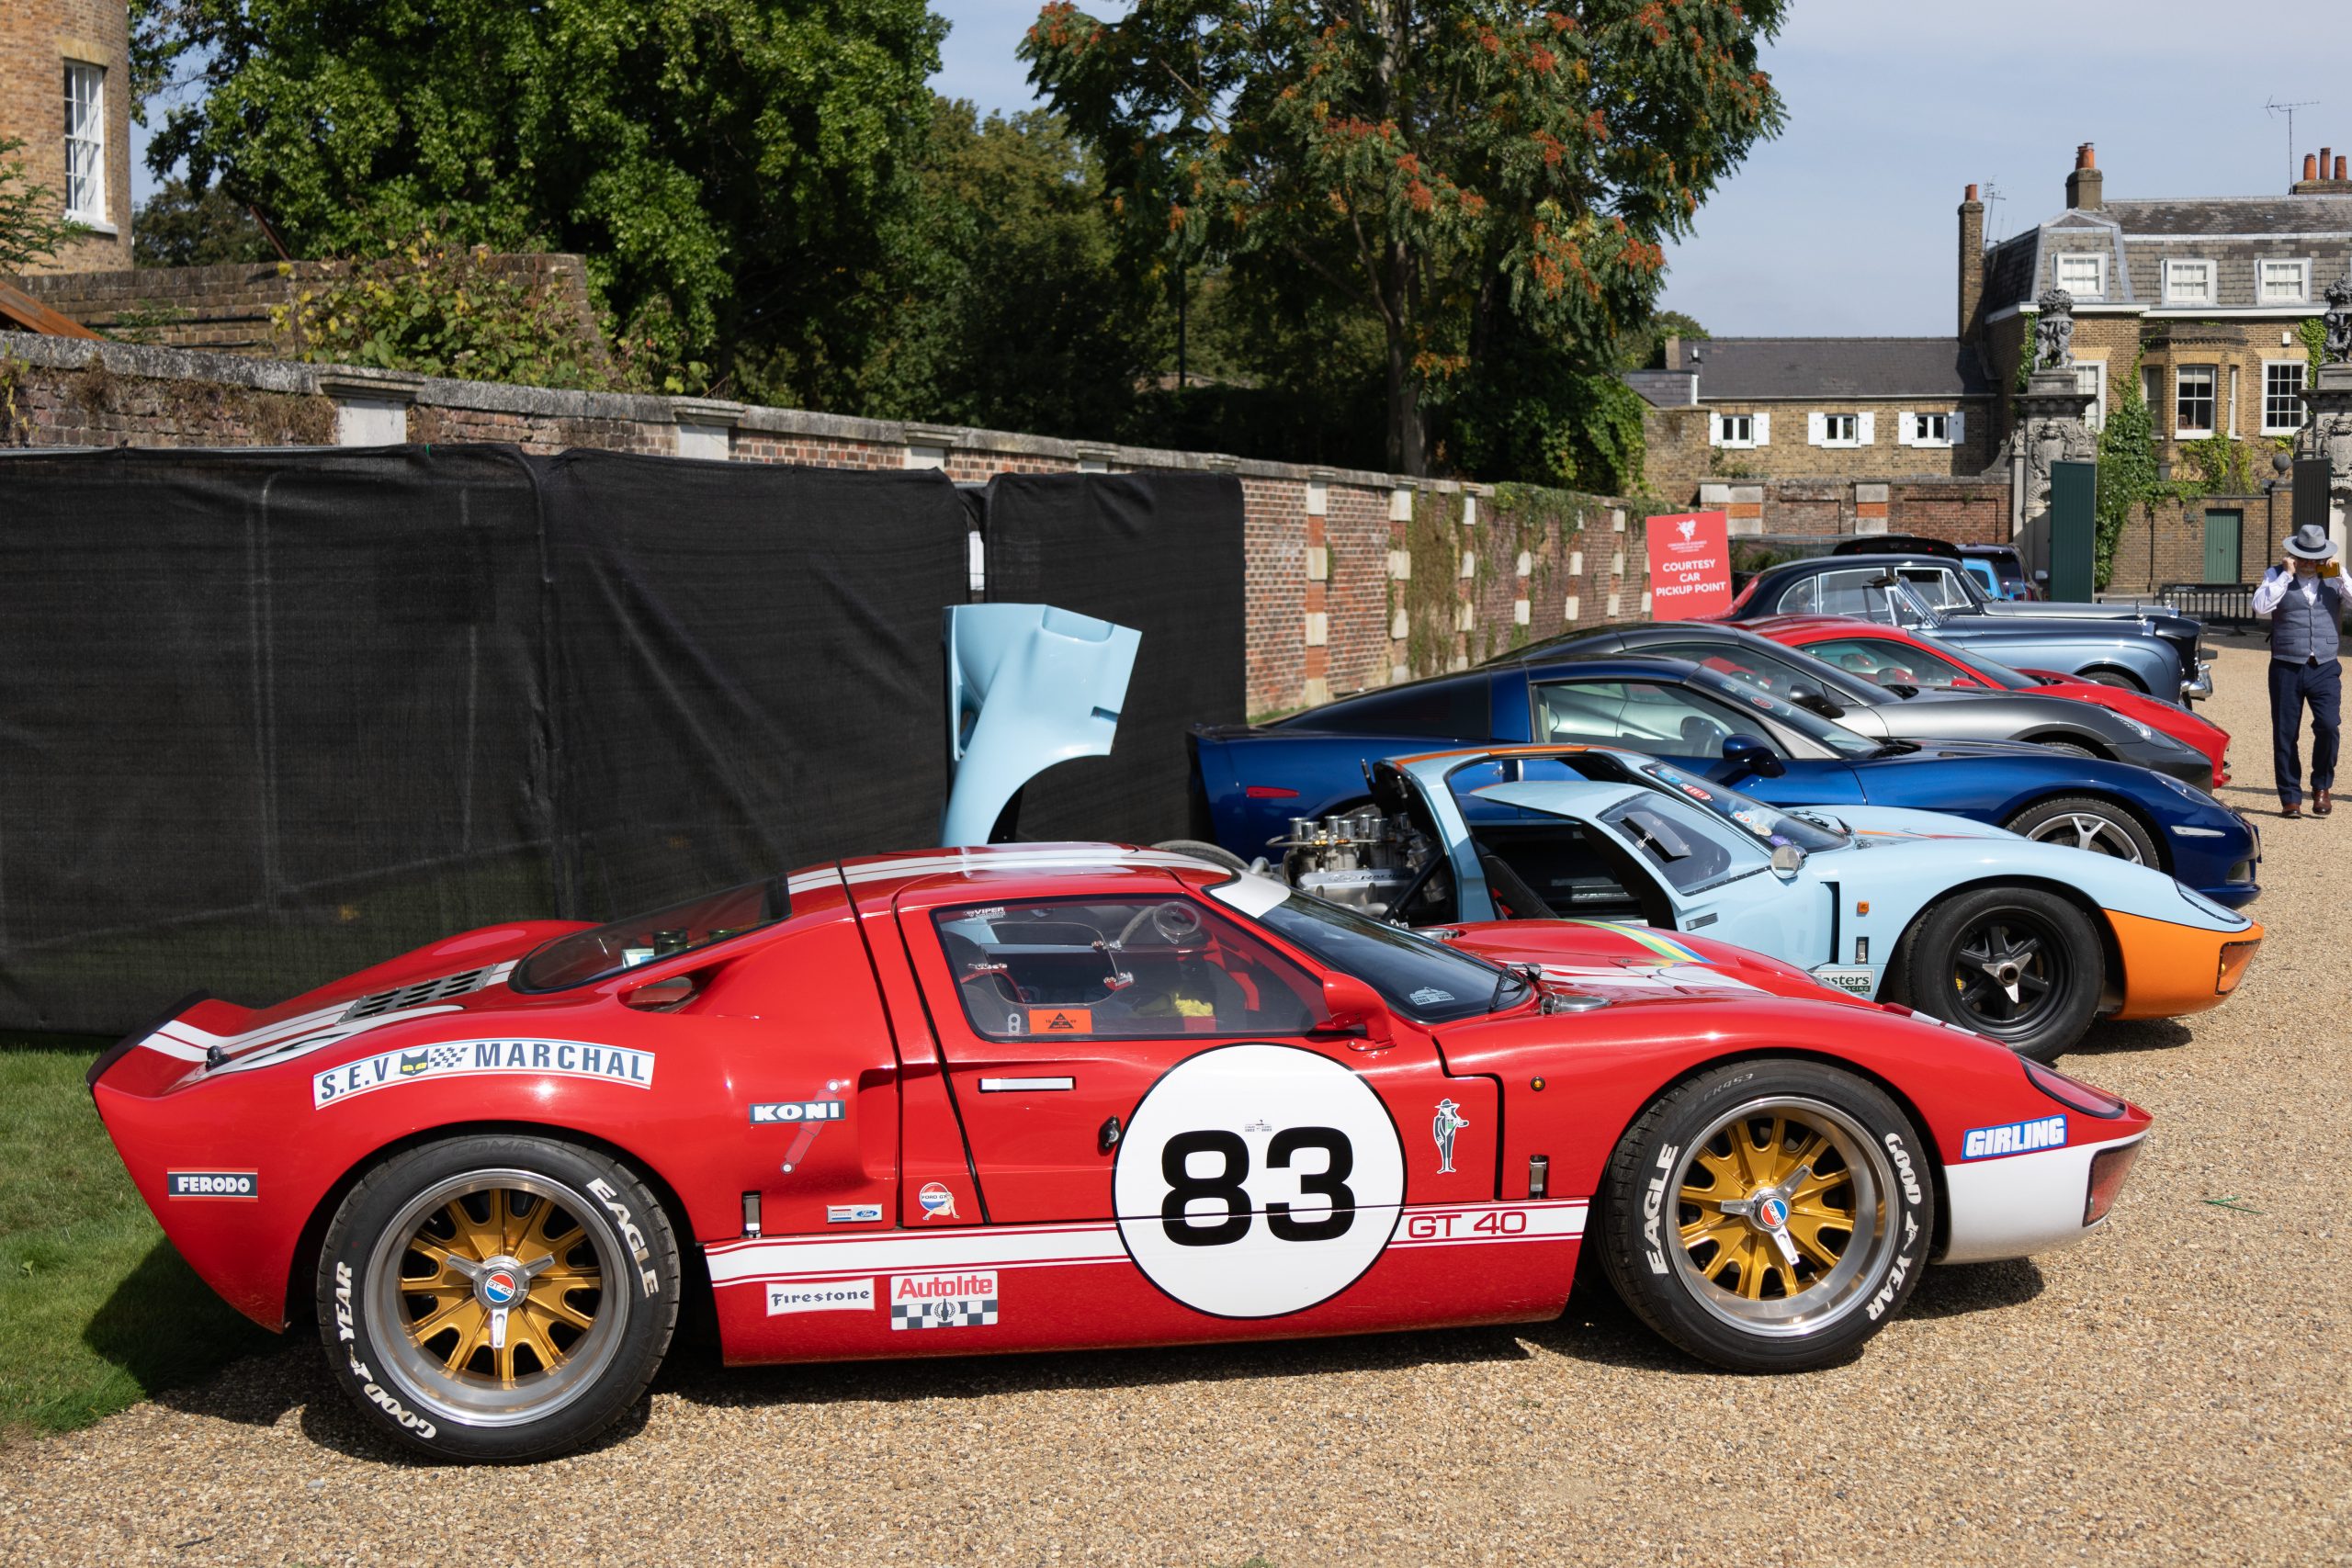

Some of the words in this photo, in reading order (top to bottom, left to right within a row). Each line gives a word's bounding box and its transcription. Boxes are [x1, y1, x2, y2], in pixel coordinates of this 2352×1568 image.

[1662, 558, 1715, 572] COURTESY
[1679, 572, 1701, 582] CAR
[1656, 584, 1692, 597] PICKUP
[1694, 581, 1726, 593] POINT
[974, 907, 1004, 915] VIPER
[475, 1043, 646, 1081] MARCHAL
[753, 1102, 840, 1122] KONI
[1965, 1118, 2065, 1157] GIRLING
[1884, 1133, 1922, 1205] GOOD
[177, 1176, 251, 1193] FERODO
[1160, 1125, 1356, 1247] 83
[1643, 1142, 1679, 1275] EAGLE
[585, 1177, 661, 1299] EAGLE
[1408, 1213, 1464, 1239] GT
[1474, 1211, 1528, 1235] 40
[334, 1261, 355, 1341] YEAR
[487, 1280, 500, 1290] GT
[501, 1287, 513, 1295] 40
[771, 1289, 871, 1307] Firestone
[897, 1275, 993, 1300] Autolite
[1865, 1255, 1913, 1321] YEAR
[363, 1382, 437, 1440] GOOD
